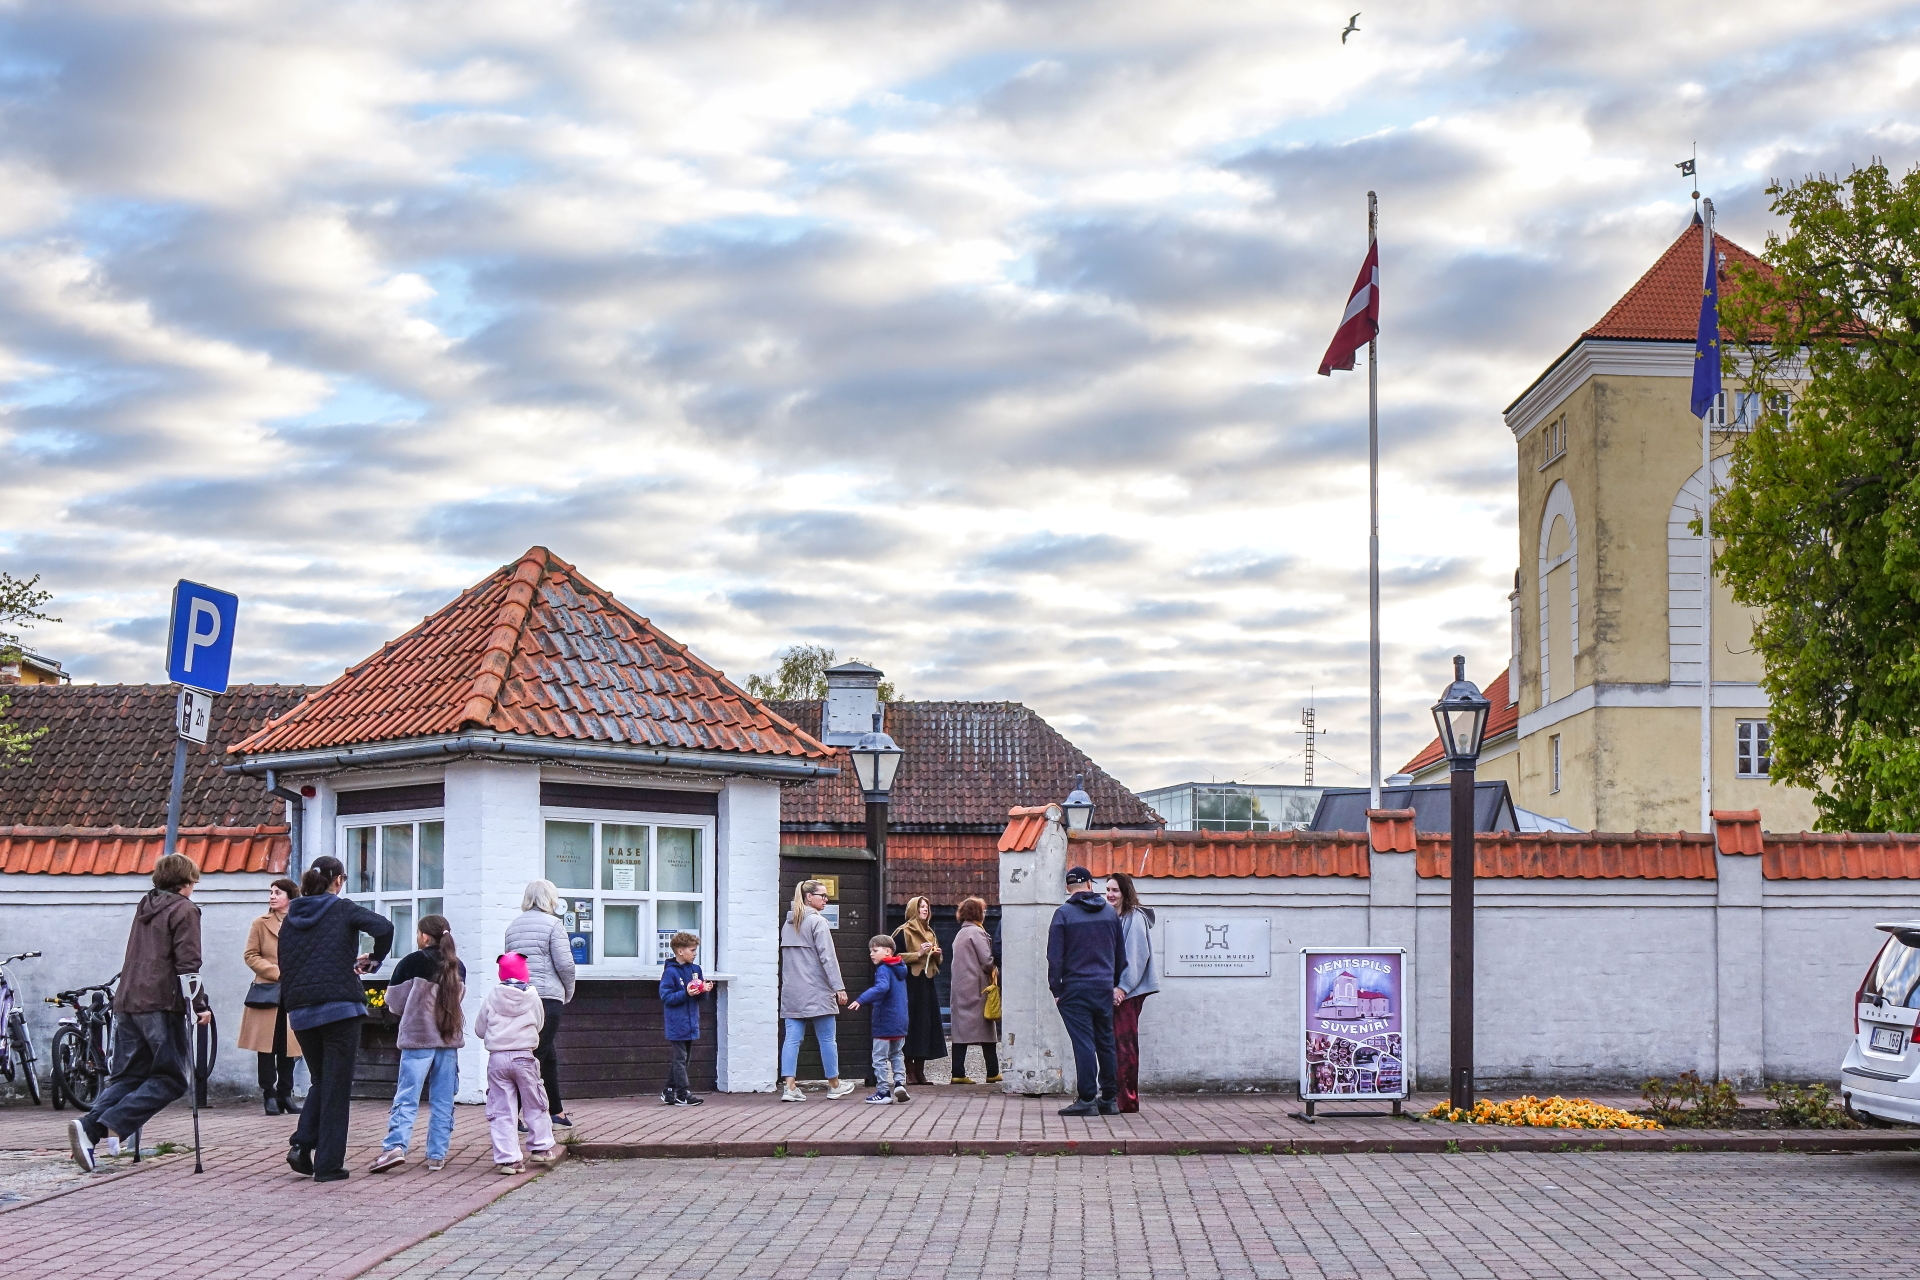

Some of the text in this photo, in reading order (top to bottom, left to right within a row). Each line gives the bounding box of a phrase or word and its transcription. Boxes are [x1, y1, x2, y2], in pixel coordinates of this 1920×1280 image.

[183, 596, 221, 673] P
[195, 708, 205, 728] 2h
[608, 847, 641, 857] KASE
[1313, 959, 1392, 975] VENTSPILS
[1320, 1019, 1389, 1034] SUVENĪRI
